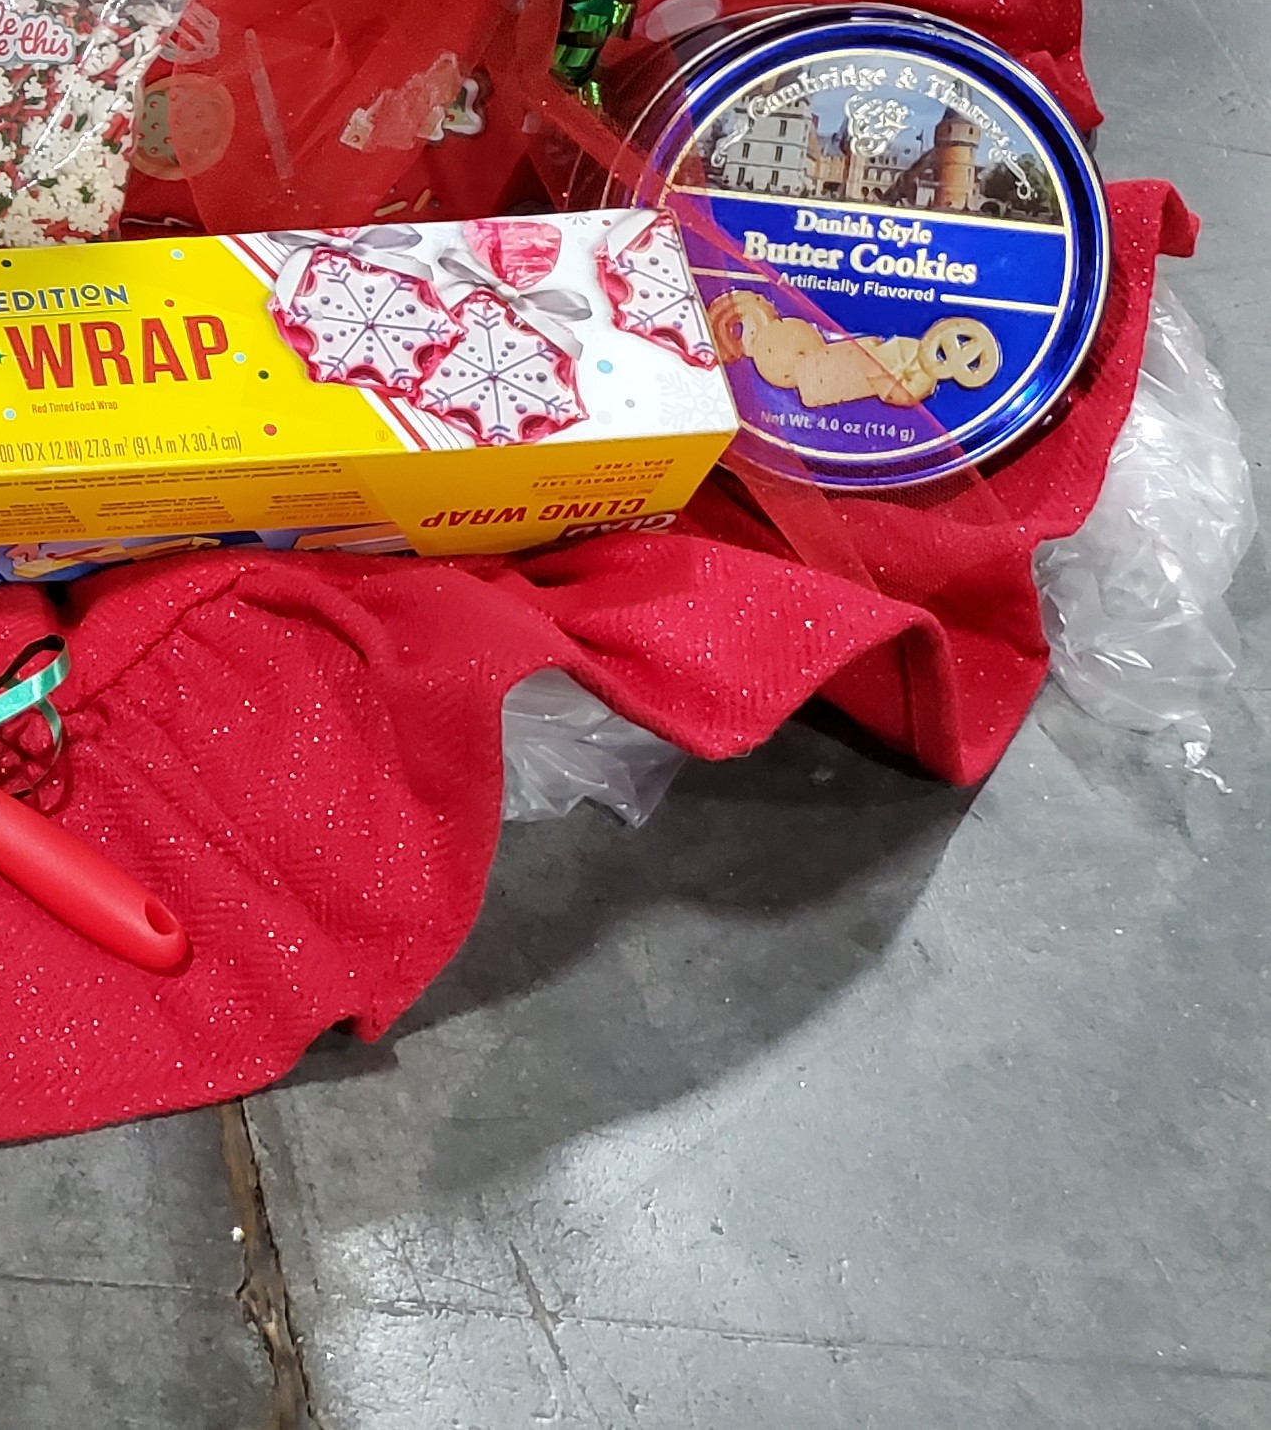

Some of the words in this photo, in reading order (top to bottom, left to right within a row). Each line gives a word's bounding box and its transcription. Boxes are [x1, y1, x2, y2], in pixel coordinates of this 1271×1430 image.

[17, 19, 69, 58] this
[747, 63, 888, 119] Cambridge
[894, 66, 919, 90] &
[793, 208, 875, 239] Danish
[877, 218, 933, 248] Style
[743, 229, 845, 271] Butter
[849, 243, 978, 285] Cookies
[777, 271, 860, 297] Artificially
[863, 280, 935, 302] Flavored
[3, 314, 230, 391] WRAP
[31, 403, 48, 414] Red
[48, 401, 75, 413] Tinted
[76, 401, 95, 412] Food
[97, 400, 119, 412] Wrap
[760, 410, 786, 427] Net
[788, 413, 813, 430] Wt.
[817, 416, 840, 432] 4.0
[843, 421, 861, 434] oz
[864, 422, 897, 439] (114
[899, 427, 916, 443] g)
[16, 442, 34, 463] YD
[34, 441, 46, 462] X
[48, 441, 64, 462] 12
[65, 439, 83, 462] IN)
[84, 438, 112, 458] 27.8
[132, 435, 164, 459] (91.4
[166, 439, 178, 454] m
[178, 433, 190, 453] X
[191, 431, 219, 452] 30.4
[221, 430, 243, 453] cm)
[419, 505, 528, 528] WRAP
[537, 497, 646, 522] CLING
